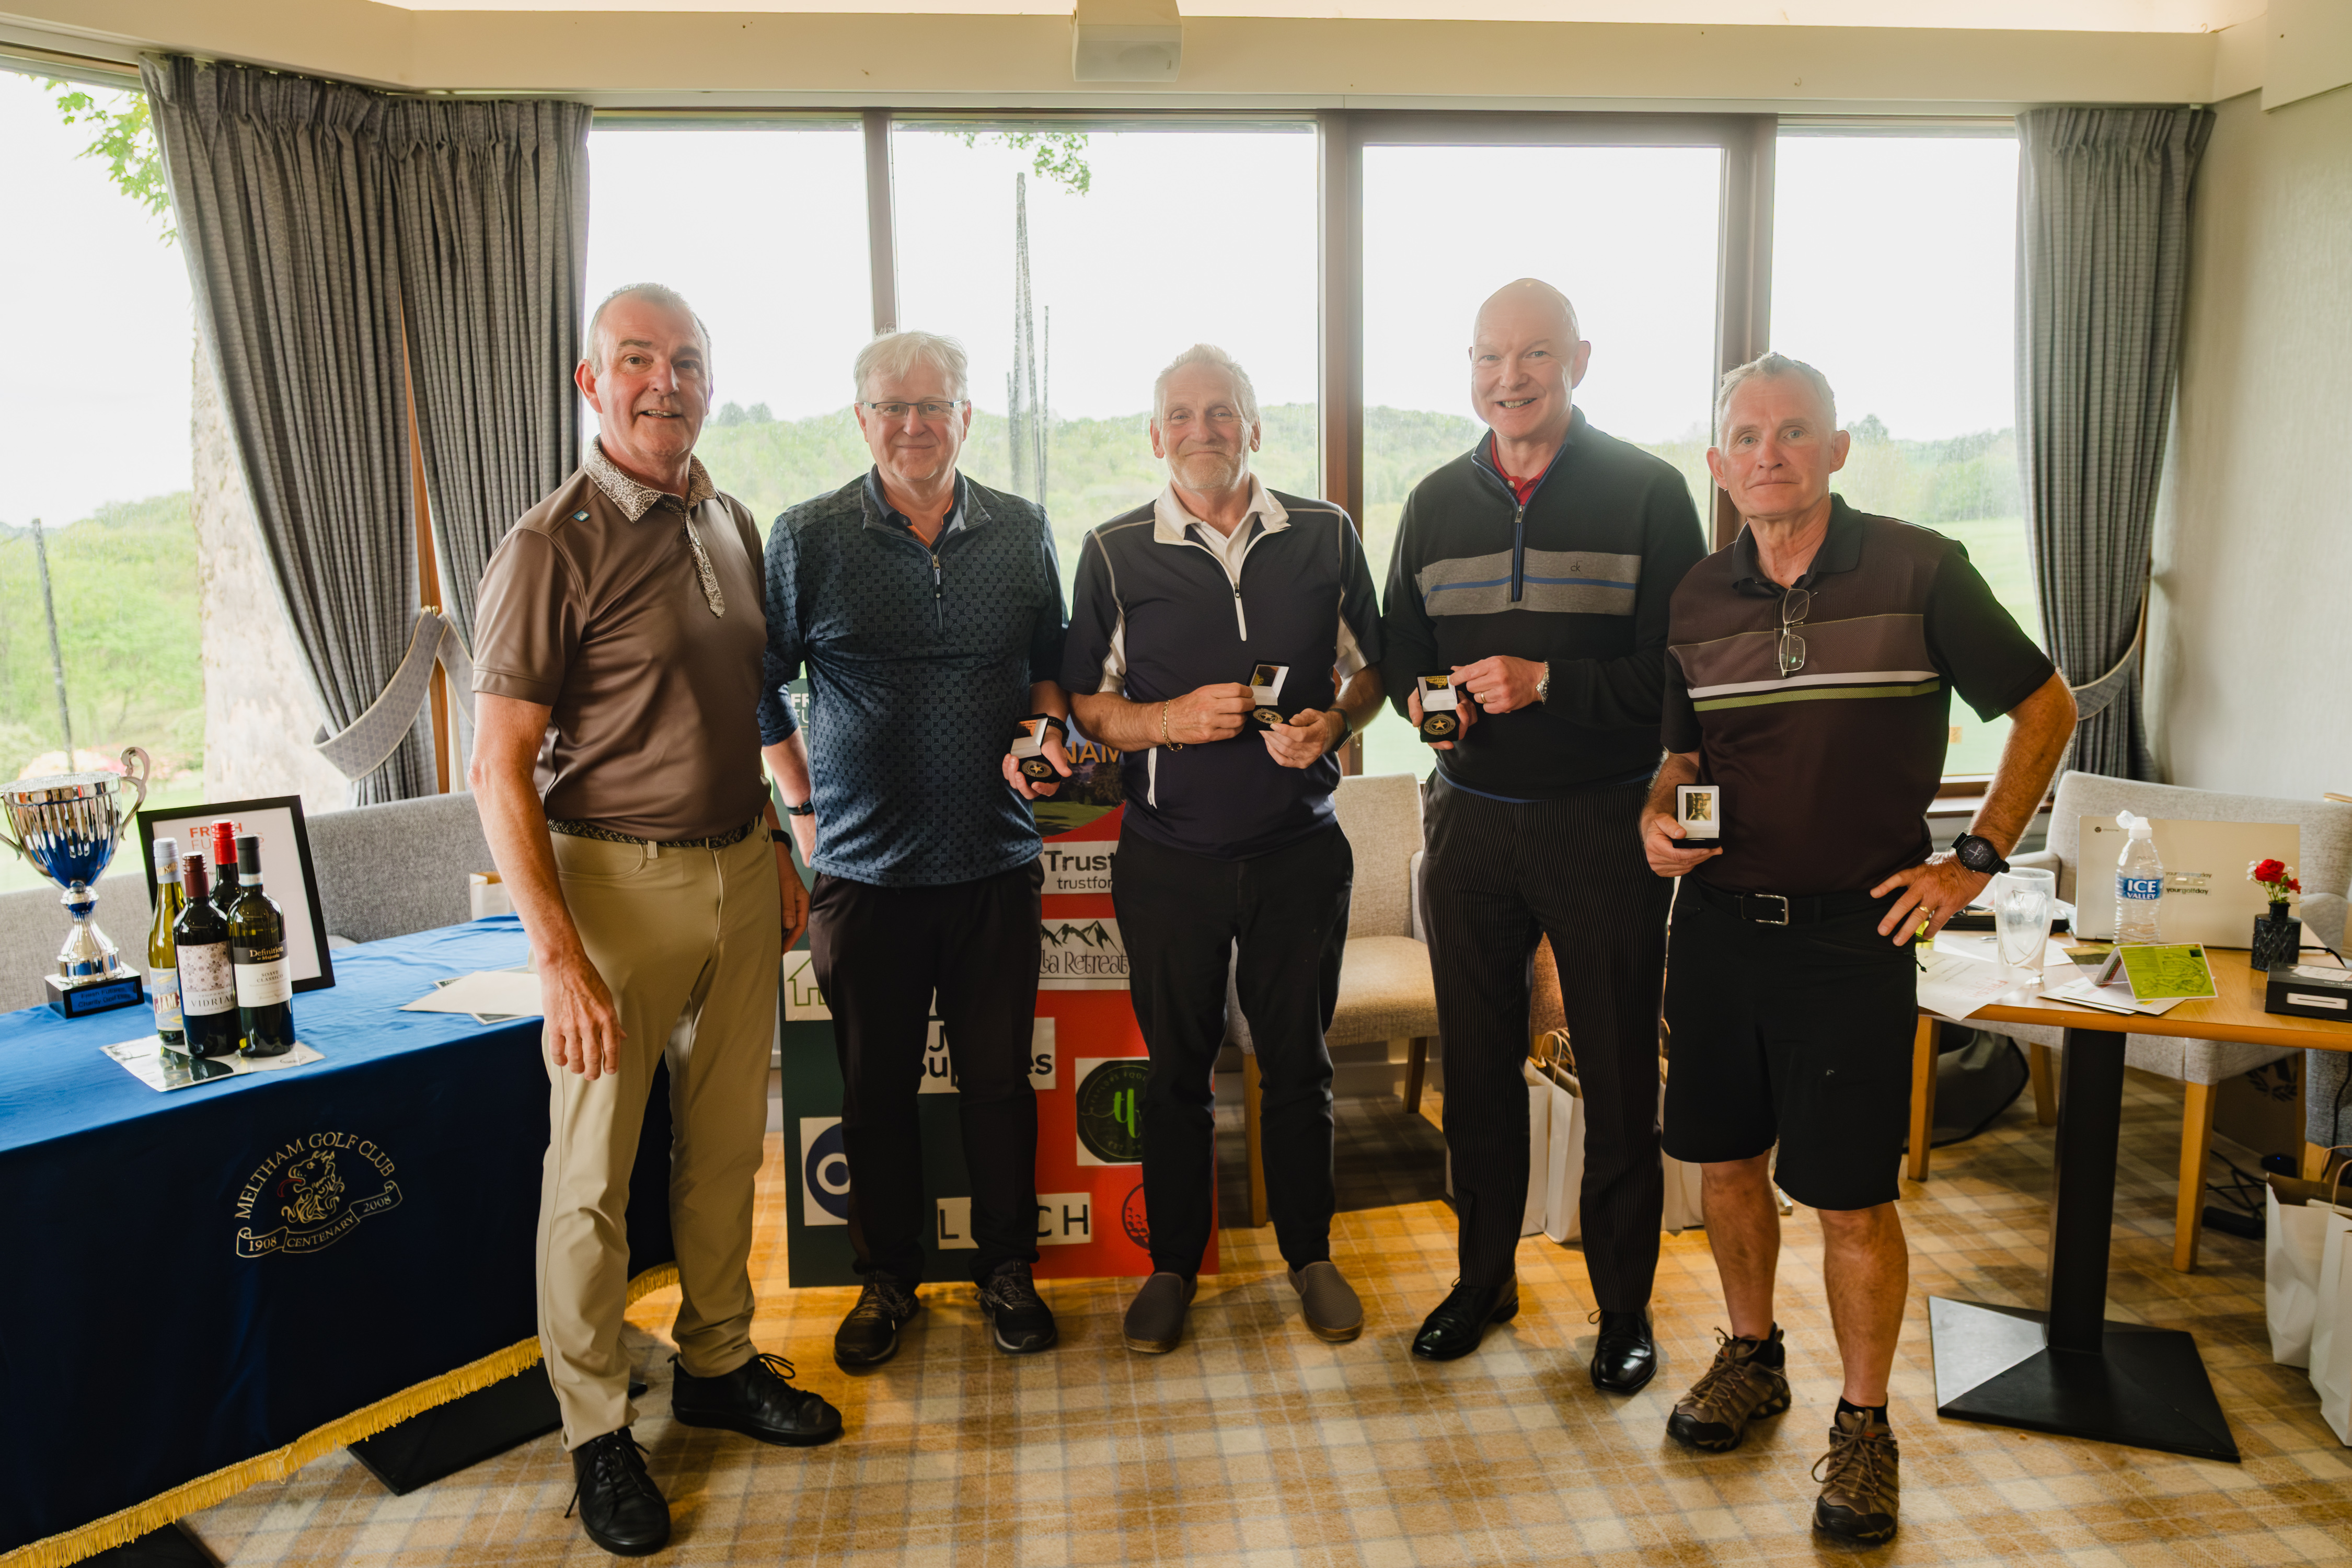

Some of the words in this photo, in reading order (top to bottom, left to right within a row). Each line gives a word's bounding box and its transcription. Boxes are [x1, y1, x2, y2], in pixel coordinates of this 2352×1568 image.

[2128, 880, 2156, 893] ICE
[249, 946, 283, 958] Definition
[1065, 946, 1128, 975] Retreat
[234, 1138, 305, 1220] MELTHAM
[309, 1132, 359, 1149] GOLF
[359, 1140, 395, 1177] CLUB
[249, 1236, 276, 1252] 1908
[286, 1215, 355, 1248] CENTENARY
[363, 1195, 391, 1213] 2008
